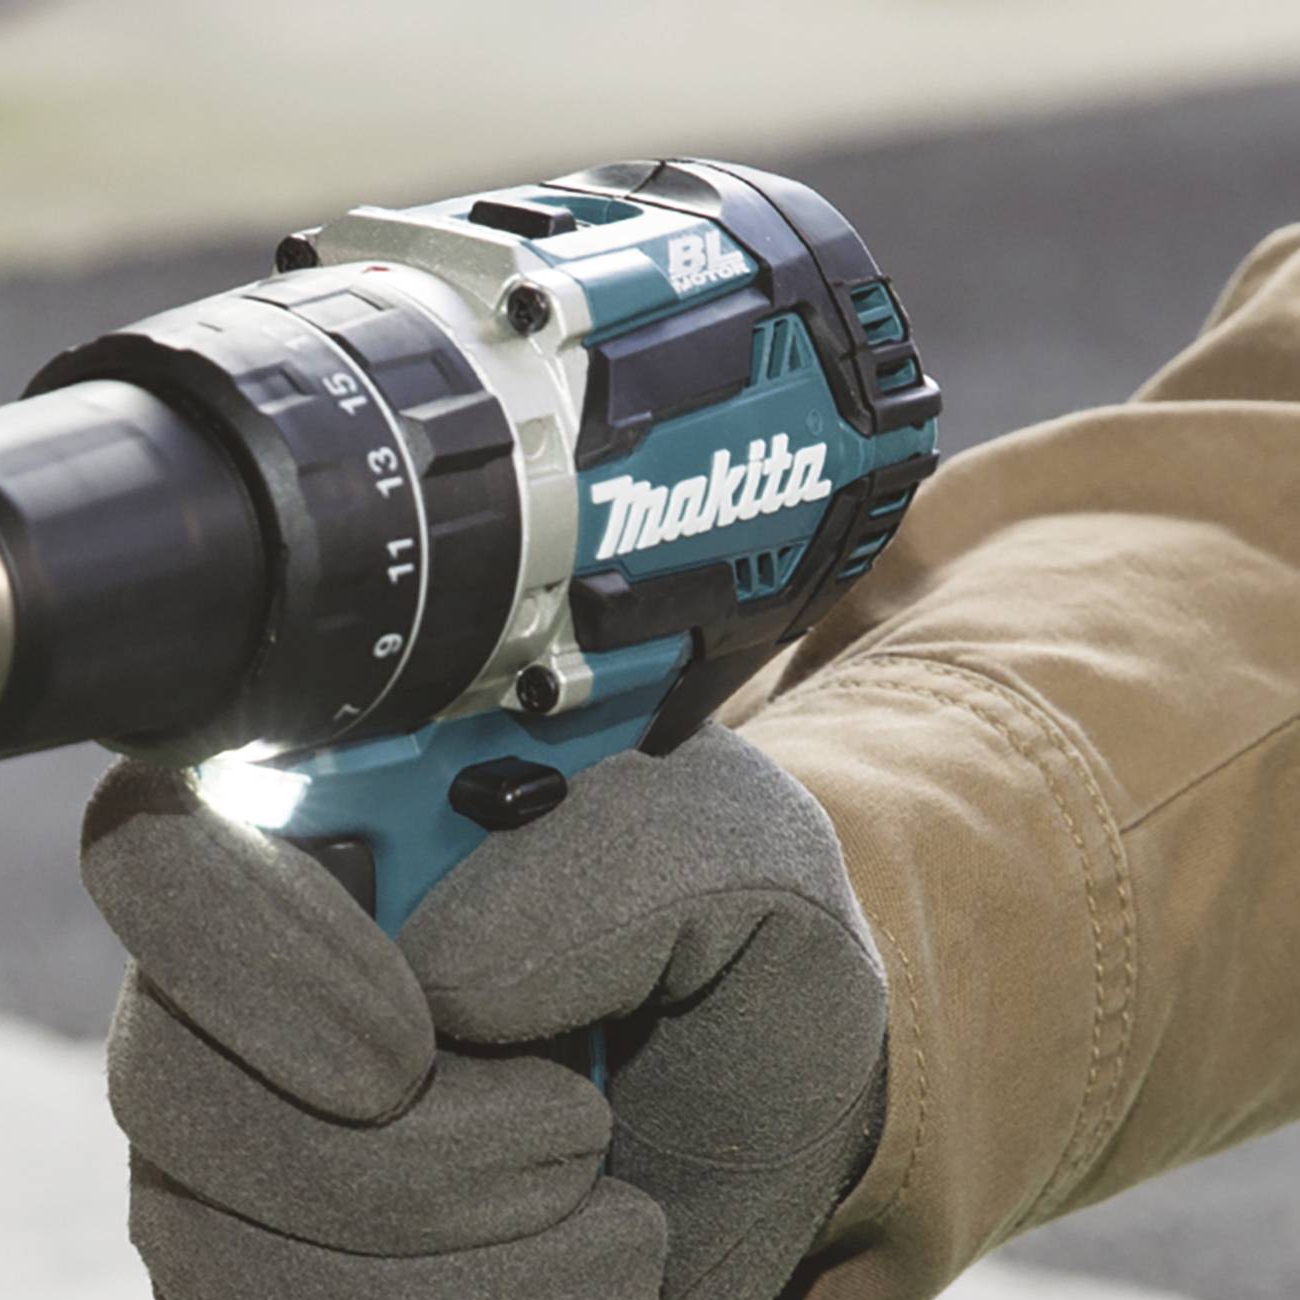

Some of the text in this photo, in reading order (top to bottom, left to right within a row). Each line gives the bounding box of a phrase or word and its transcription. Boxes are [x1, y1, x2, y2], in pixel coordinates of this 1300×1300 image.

[668, 229, 745, 273] BL
[669, 261, 751, 294] MOTOR
[322, 371, 367, 416] 15
[367, 446, 404, 498] 13
[387, 537, 414, 584] 11
